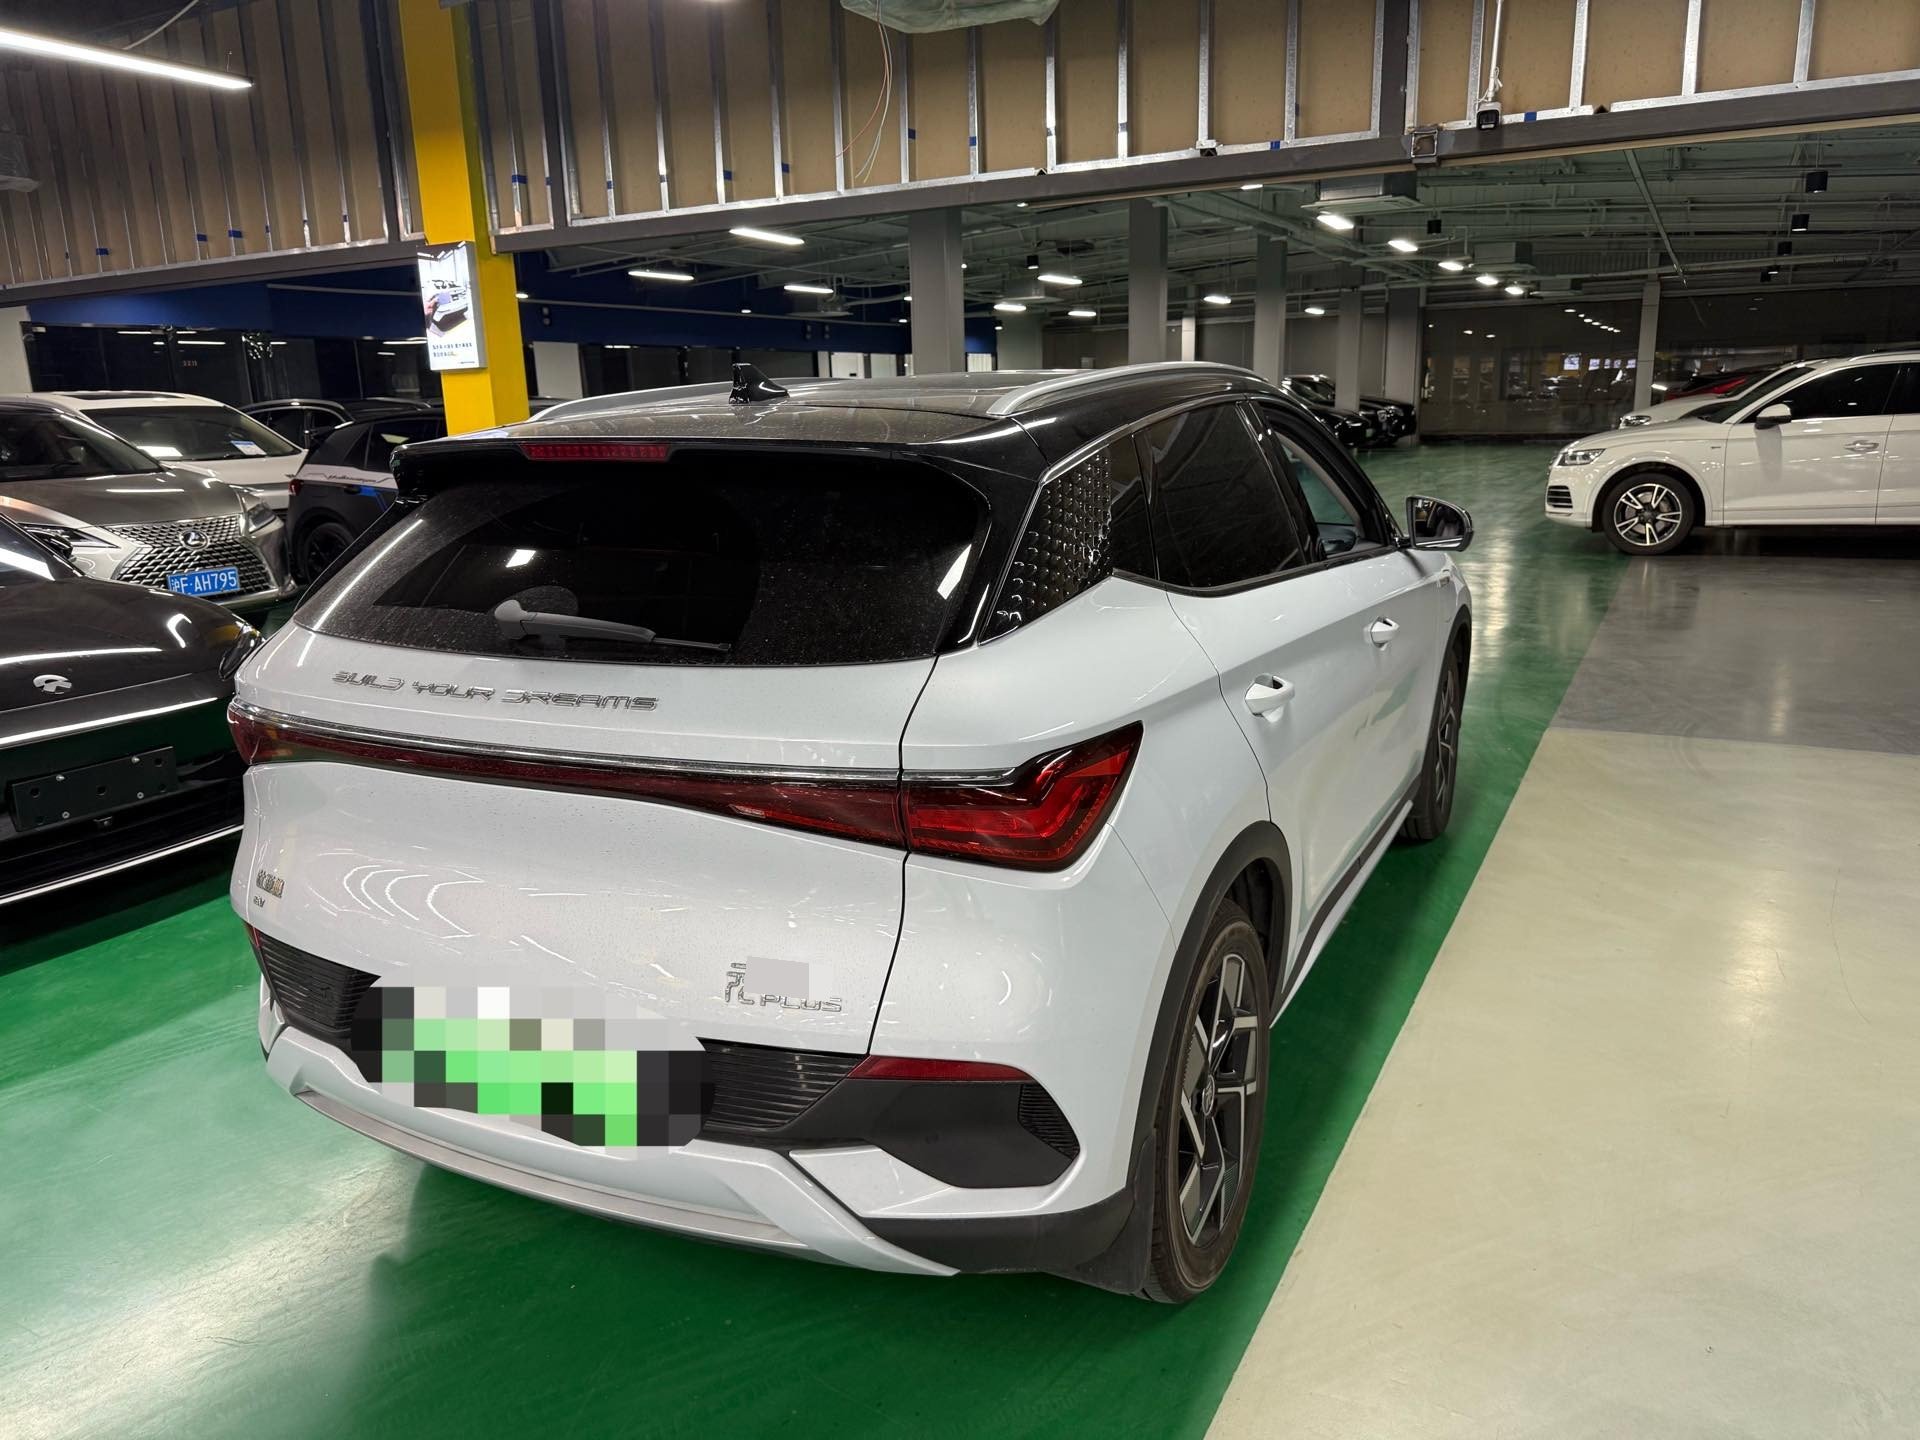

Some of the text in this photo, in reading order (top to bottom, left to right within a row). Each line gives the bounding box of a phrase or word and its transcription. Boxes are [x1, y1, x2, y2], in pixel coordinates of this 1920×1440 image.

[332, 671, 659, 711] BUILD YOUR DREAMS
[760, 994, 842, 1012] PLUS
